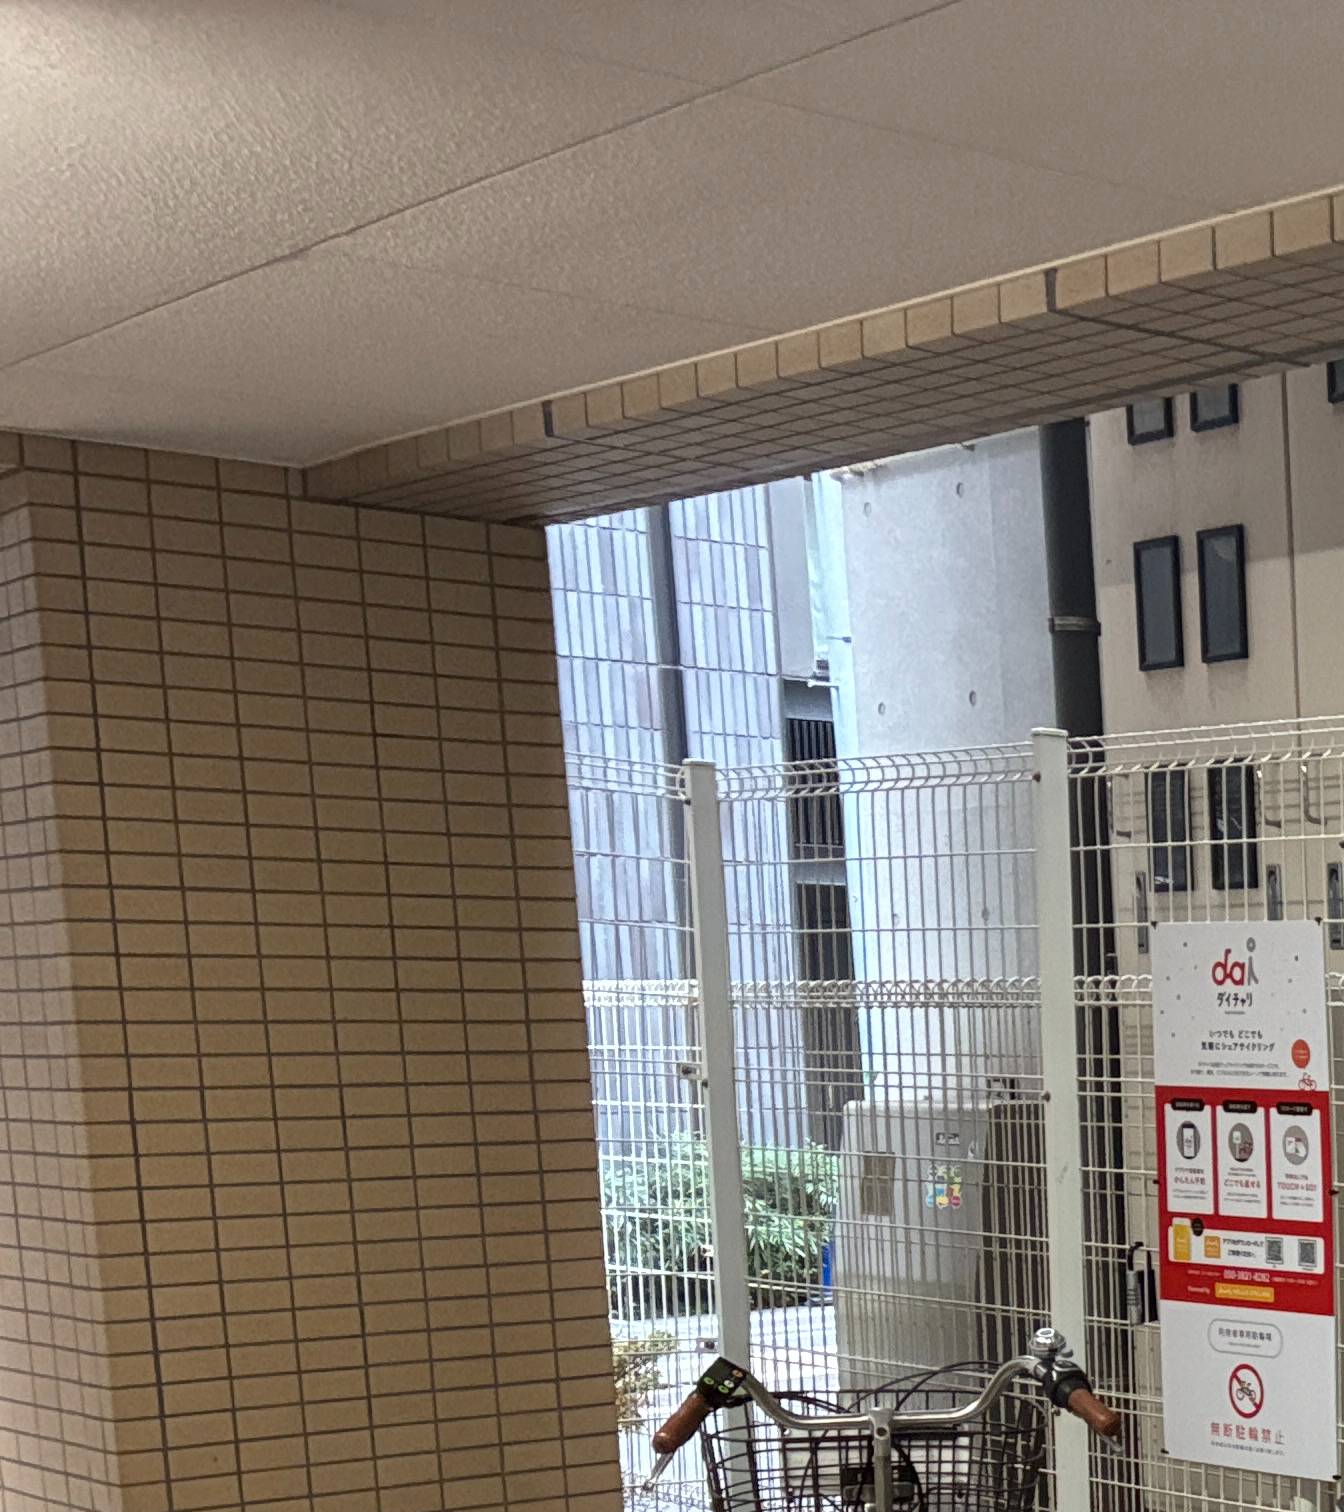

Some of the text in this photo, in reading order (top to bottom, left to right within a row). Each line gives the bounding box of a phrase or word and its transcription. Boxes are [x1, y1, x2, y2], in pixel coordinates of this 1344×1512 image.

[1212, 937, 1259, 986] dai
[1217, 992, 1253, 1008] ダイチャリ
[1209, 1030, 1263, 1040] いつでも どこでも
[1210, 1422, 1285, 1445] 無断駐輪禁止
